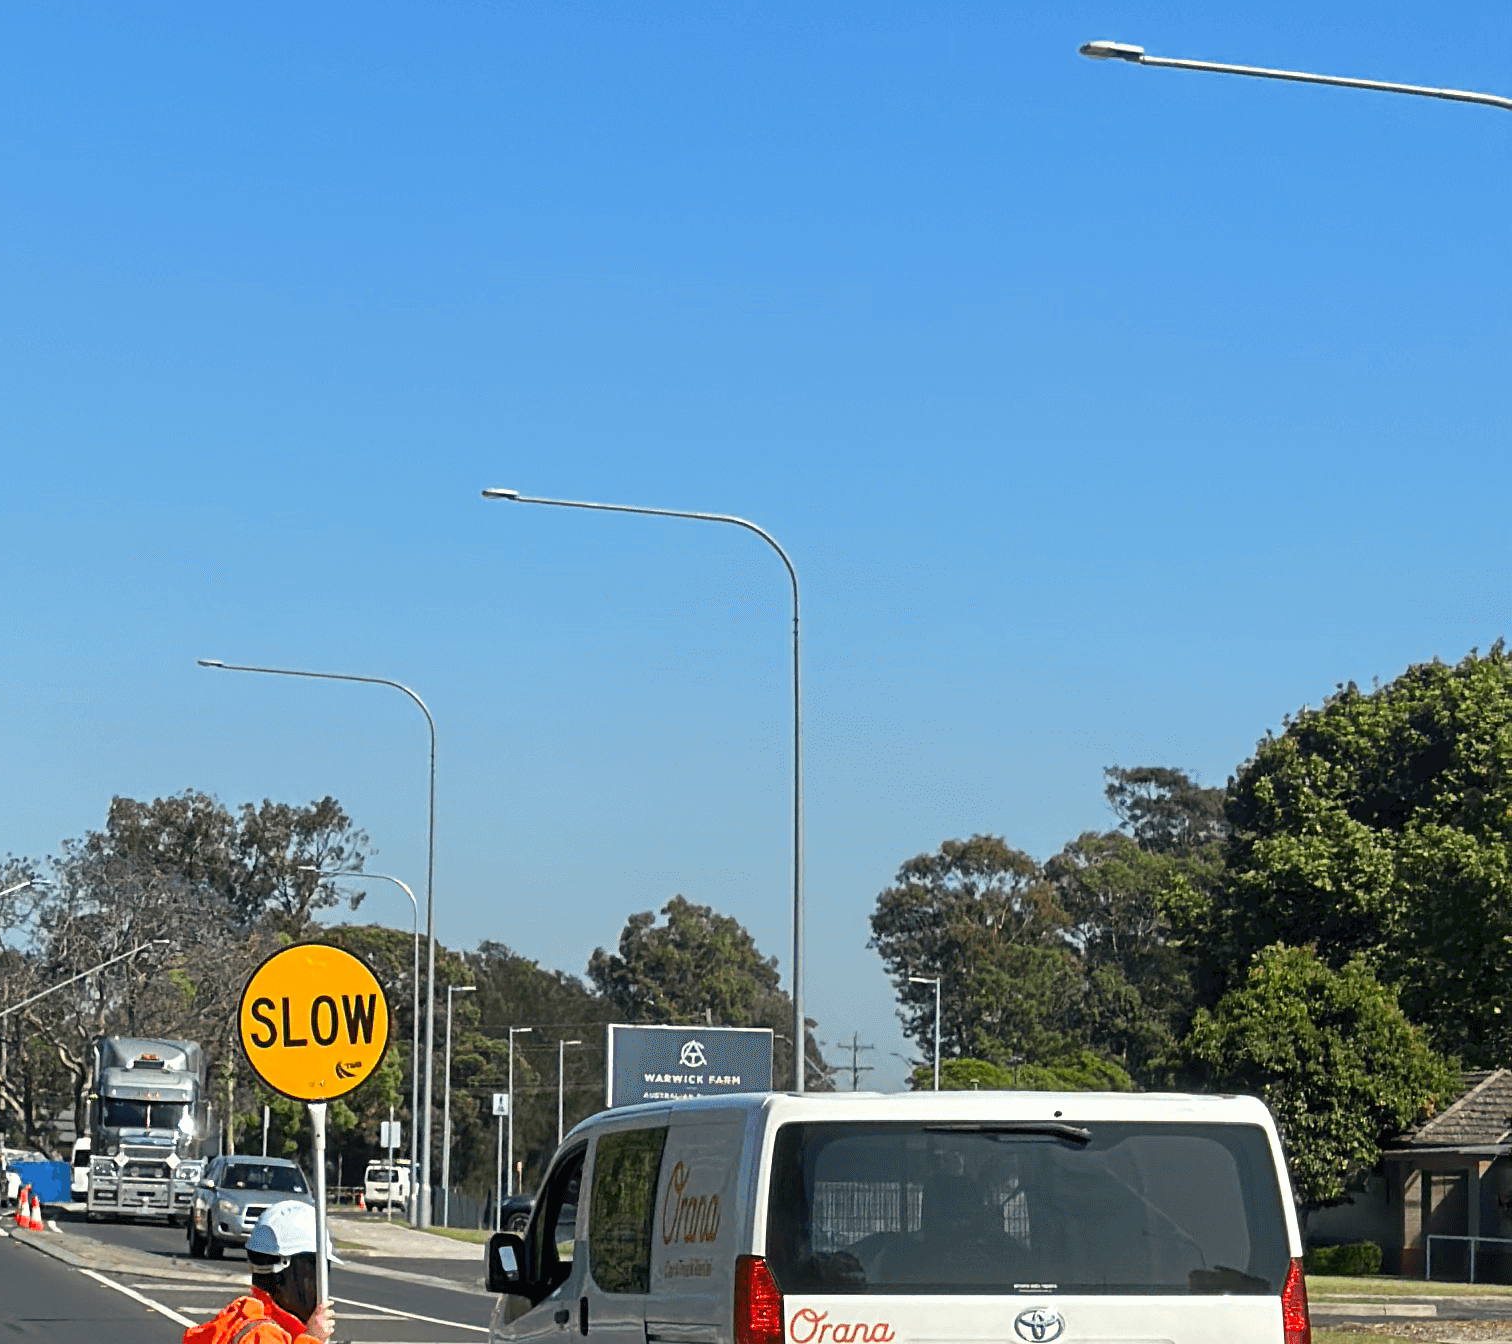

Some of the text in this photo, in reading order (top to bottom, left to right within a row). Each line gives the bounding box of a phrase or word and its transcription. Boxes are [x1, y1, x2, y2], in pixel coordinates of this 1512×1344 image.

[250, 993, 377, 1049] SLOW
[644, 1073, 741, 1086] WARWICK FARM
[663, 1160, 720, 1245] Orana
[790, 1307, 895, 1344] Orana
